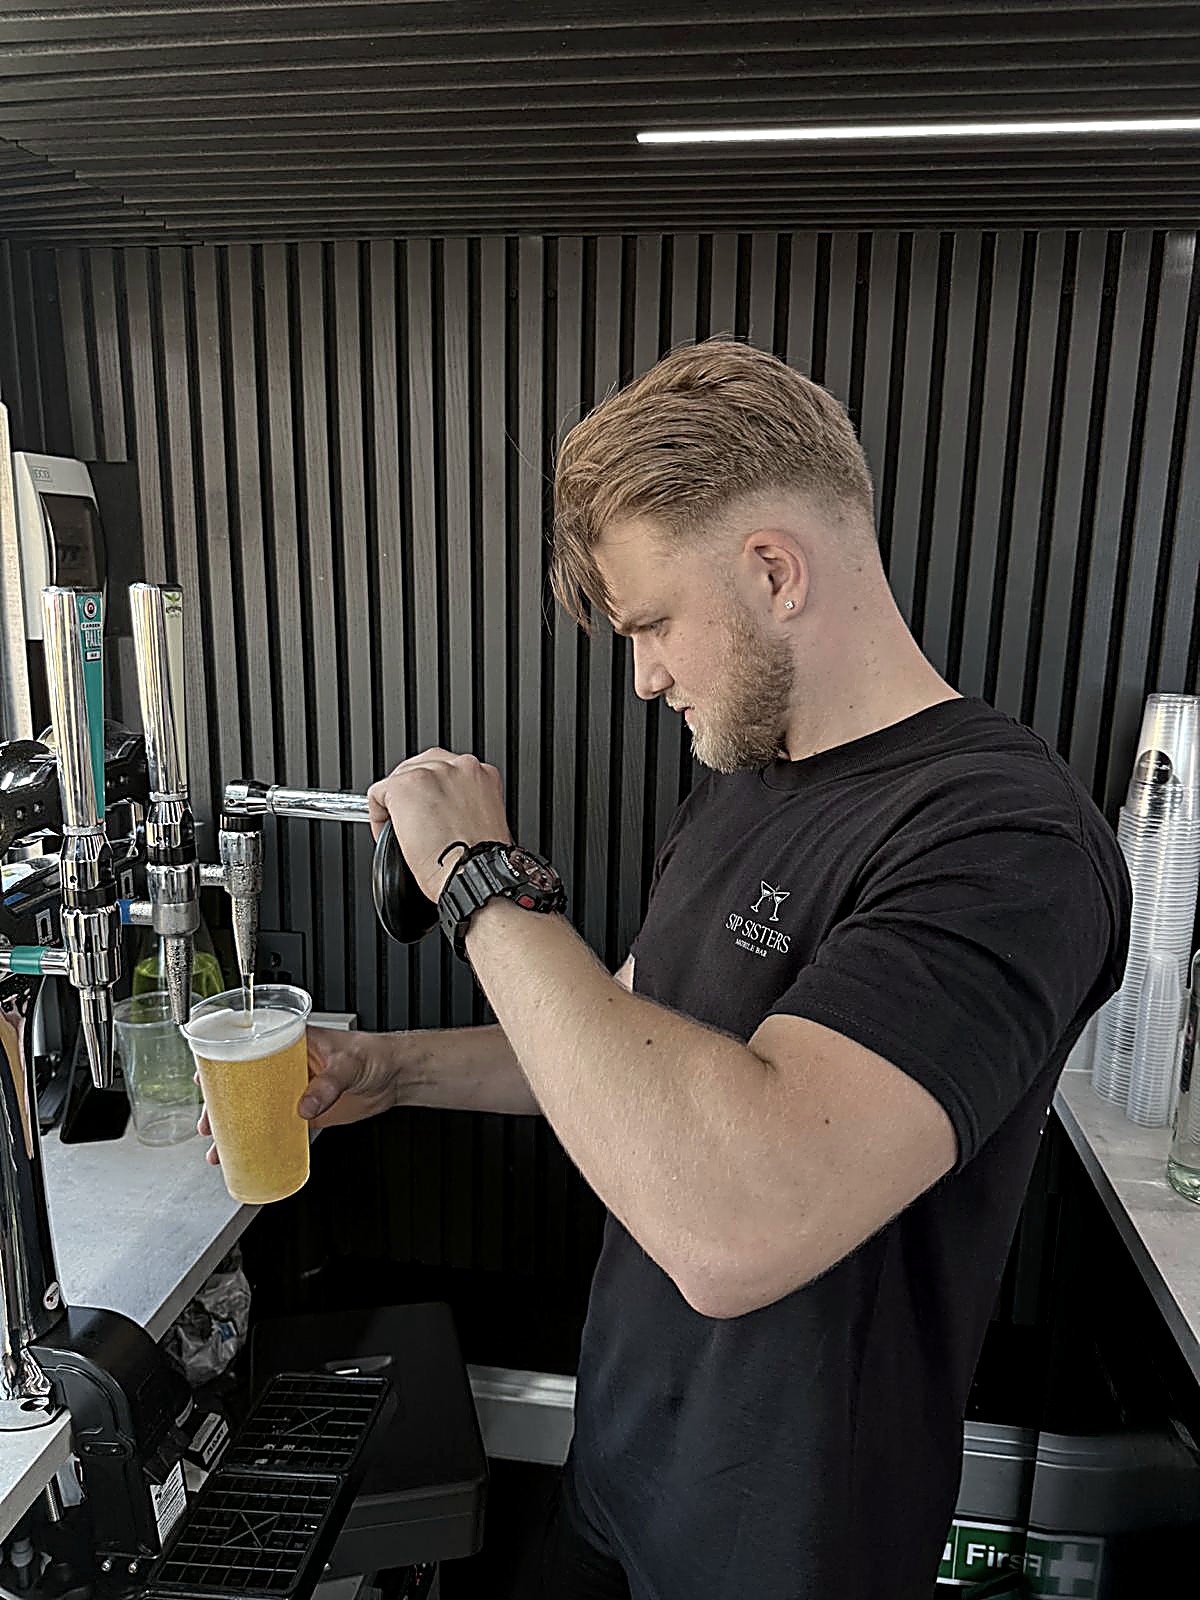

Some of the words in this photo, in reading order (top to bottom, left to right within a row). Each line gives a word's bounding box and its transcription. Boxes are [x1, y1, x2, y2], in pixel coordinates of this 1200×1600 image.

[725, 913, 743, 932] SIP
[741, 919, 791, 954] SISTERS
[965, 1542, 1023, 1570] Firs
